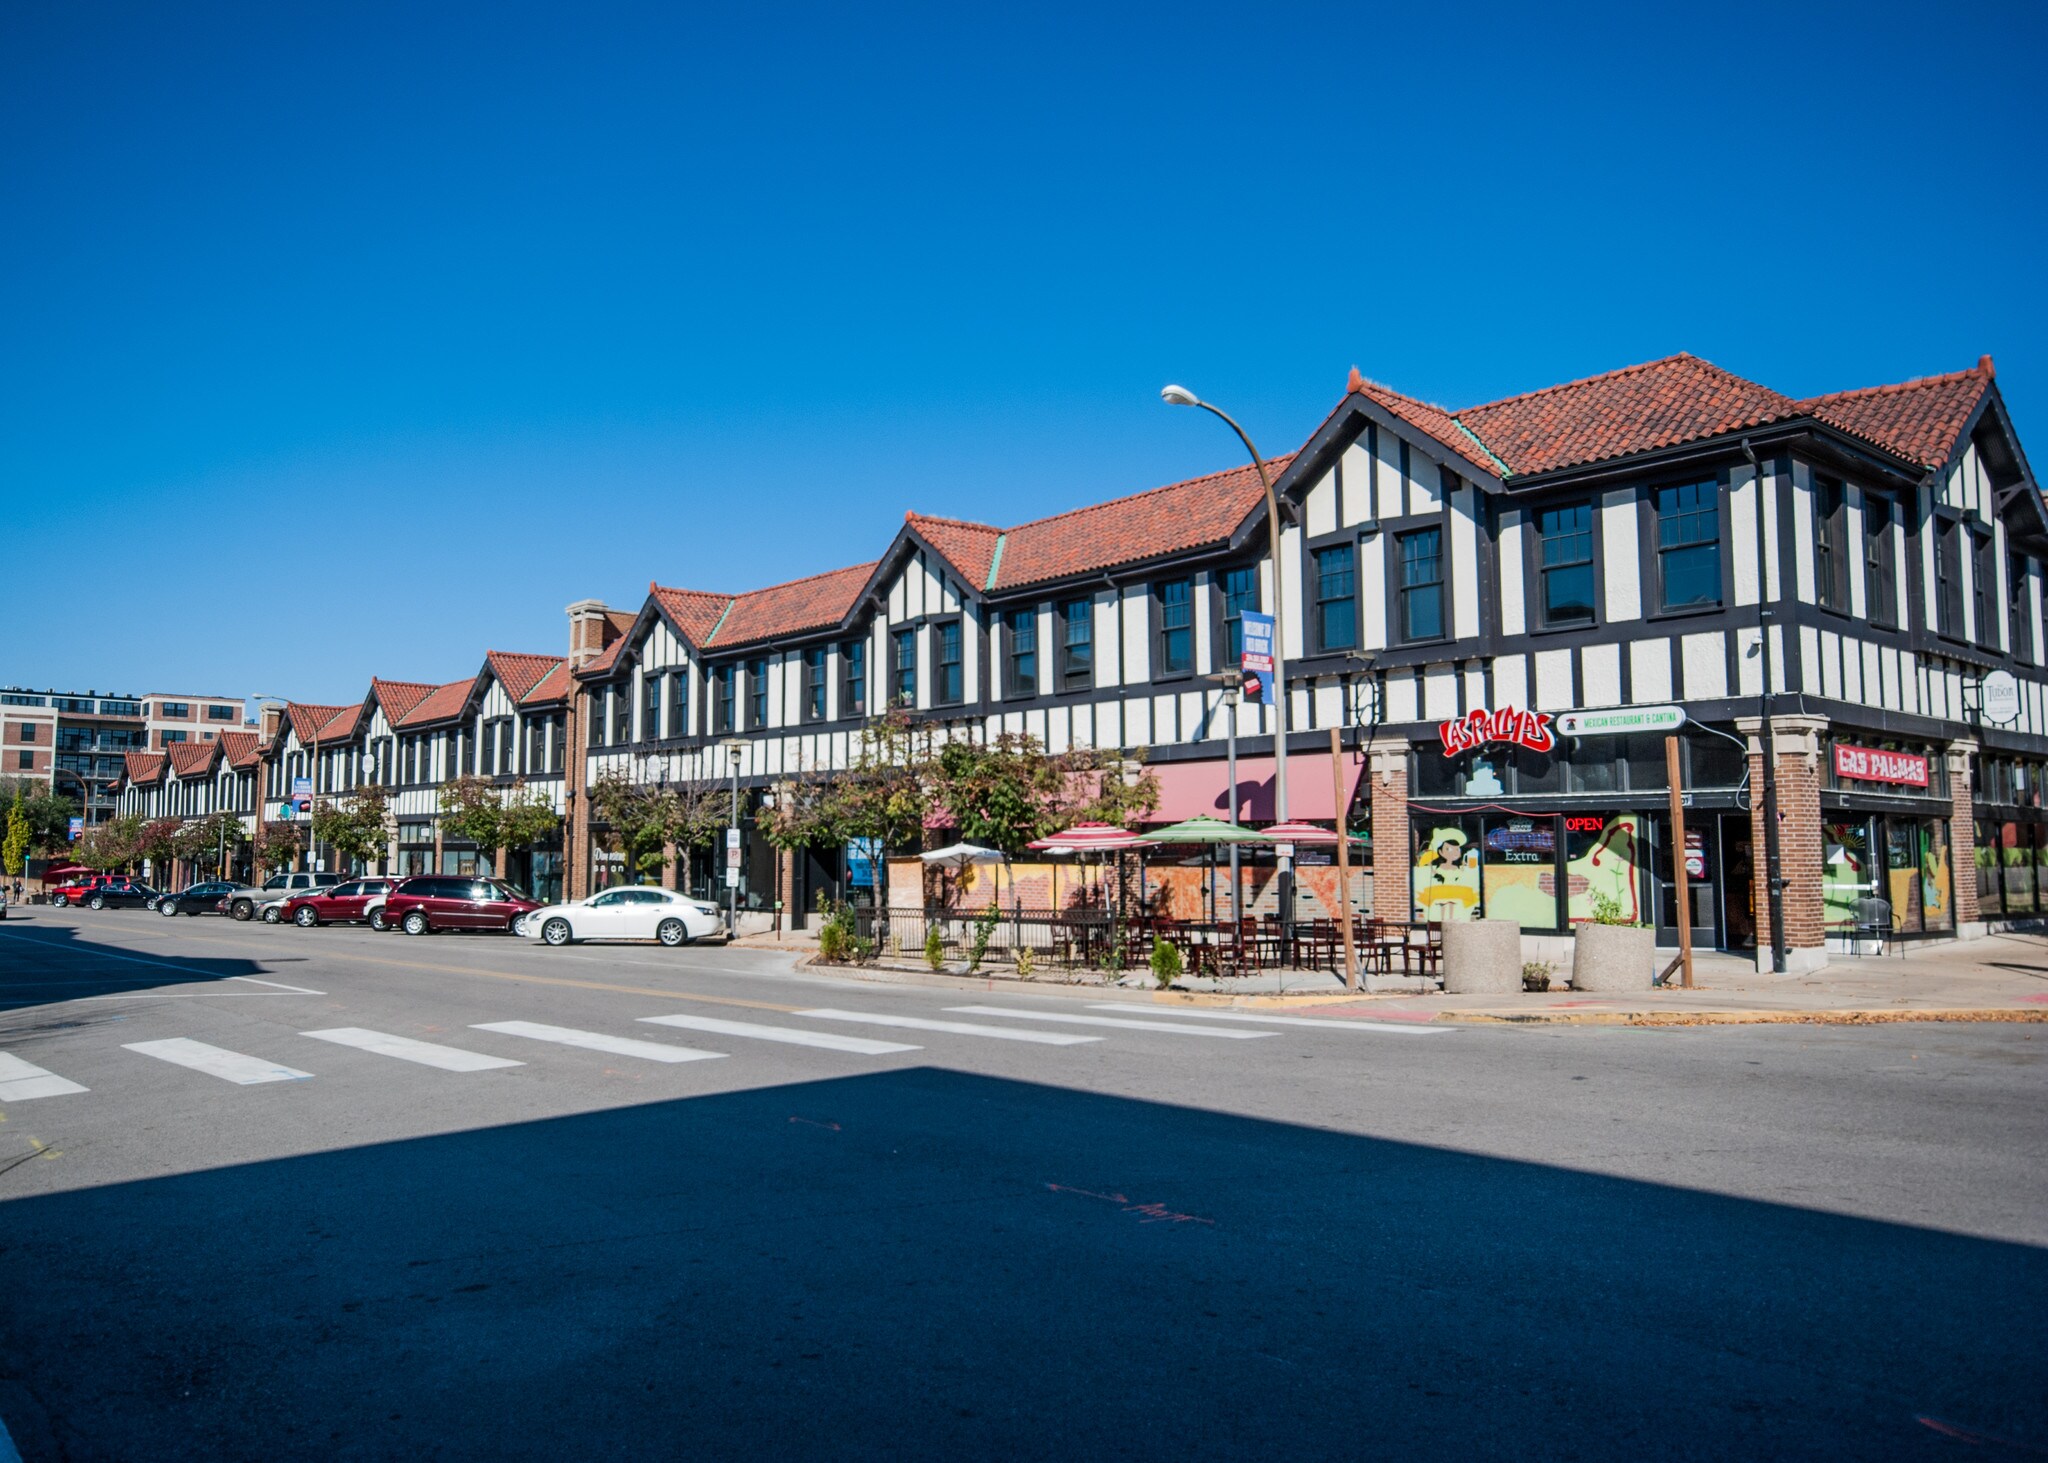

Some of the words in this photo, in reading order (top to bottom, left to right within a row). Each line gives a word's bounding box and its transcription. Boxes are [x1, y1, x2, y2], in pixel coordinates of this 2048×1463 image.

[1584, 716, 1609, 729] MEXICAN
[1609, 714, 1645, 727] RESTAURANT
[1645, 713, 1651, 724] &
[1651, 711, 1677, 723] CANTINA
[1439, 718, 1473, 758] LAS
[1469, 704, 1555, 753] PALMAS
[1838, 748, 1867, 775] LAS
[1870, 753, 1925, 782] PALMAS
[1566, 817, 1603, 831] OPEN
[1488, 828, 1552, 850] Corona
[1505, 849, 1539, 861] Extra
